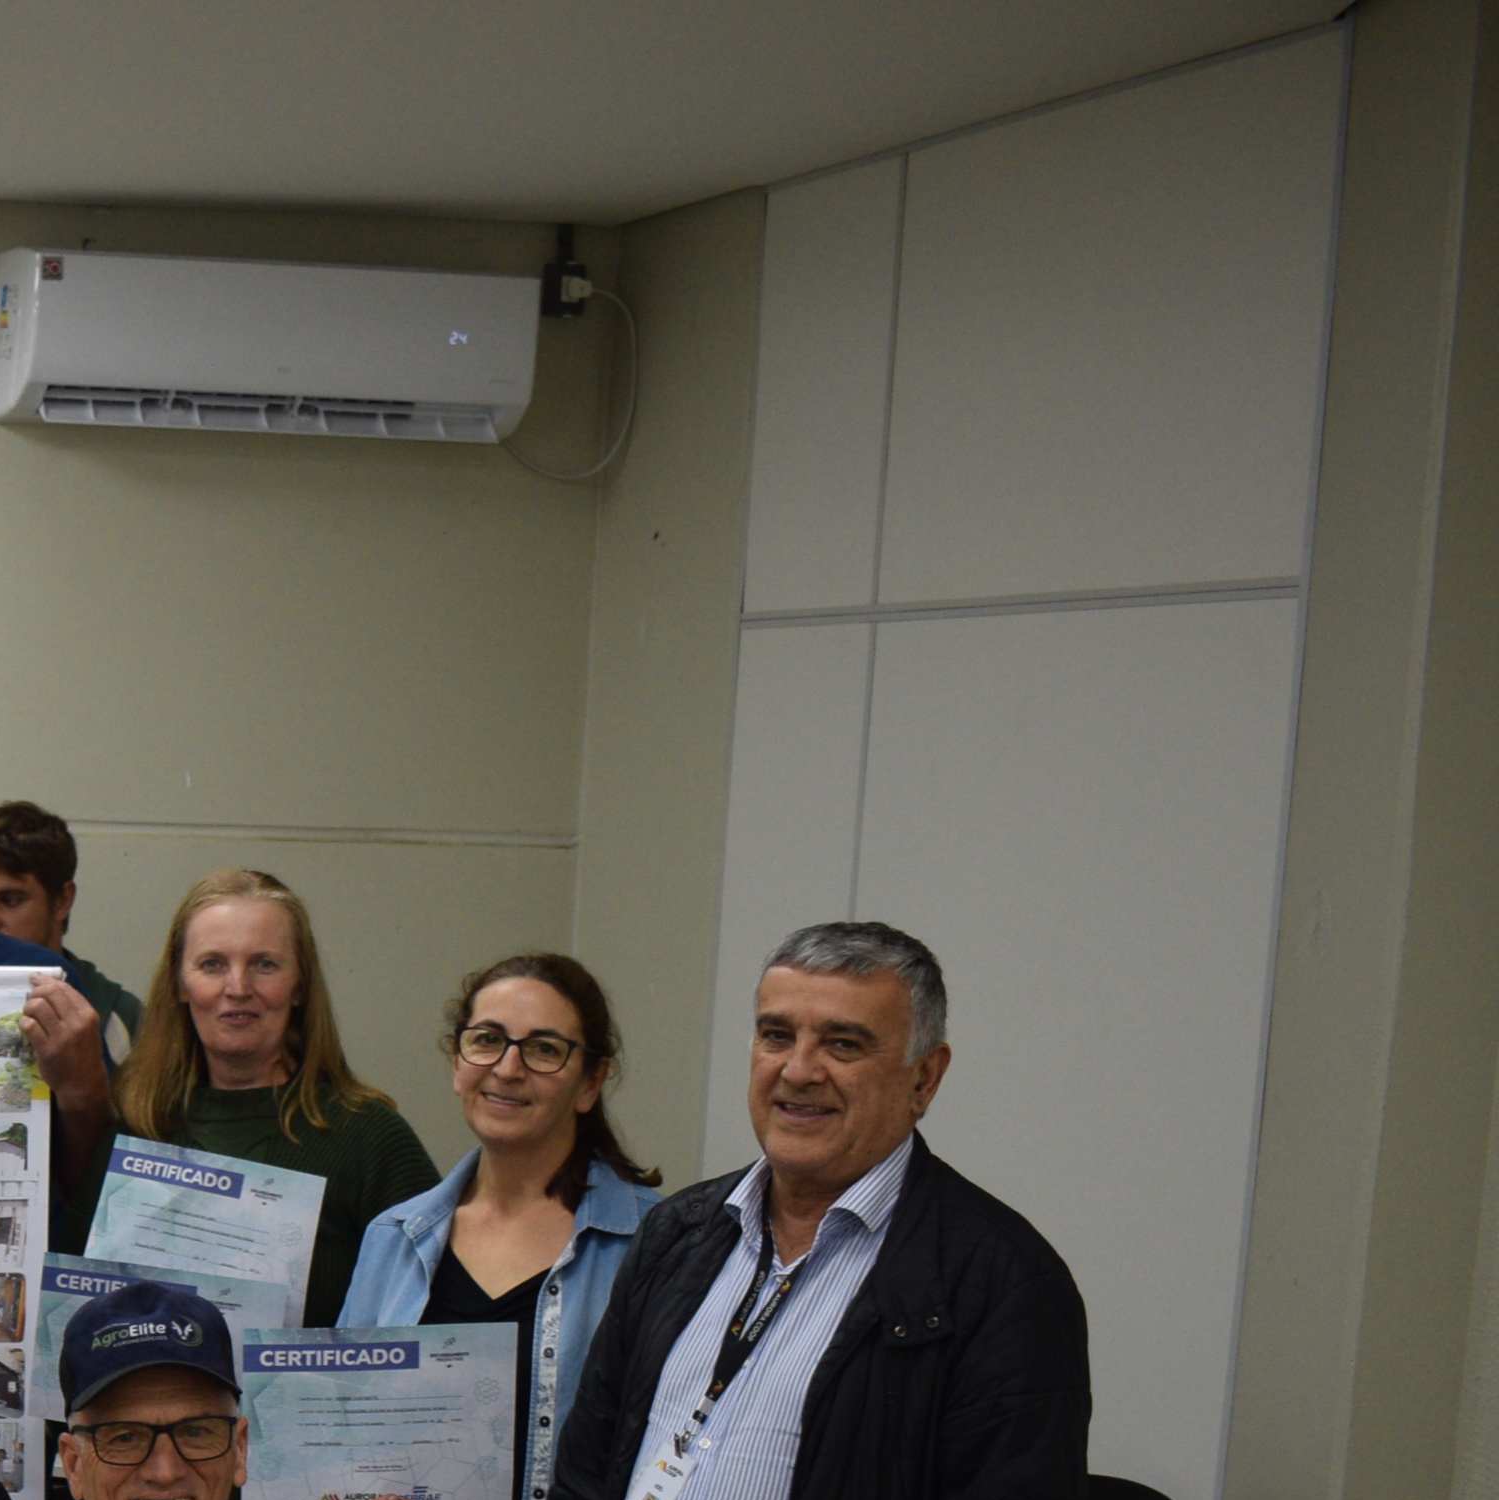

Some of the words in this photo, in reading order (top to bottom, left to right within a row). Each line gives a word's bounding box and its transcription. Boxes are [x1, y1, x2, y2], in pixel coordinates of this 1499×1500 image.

[122, 1155, 233, 1191] CERTIFICADO
[91, 1322, 167, 1351] AgroElite
[259, 1347, 406, 1368] CERTIFICADO
